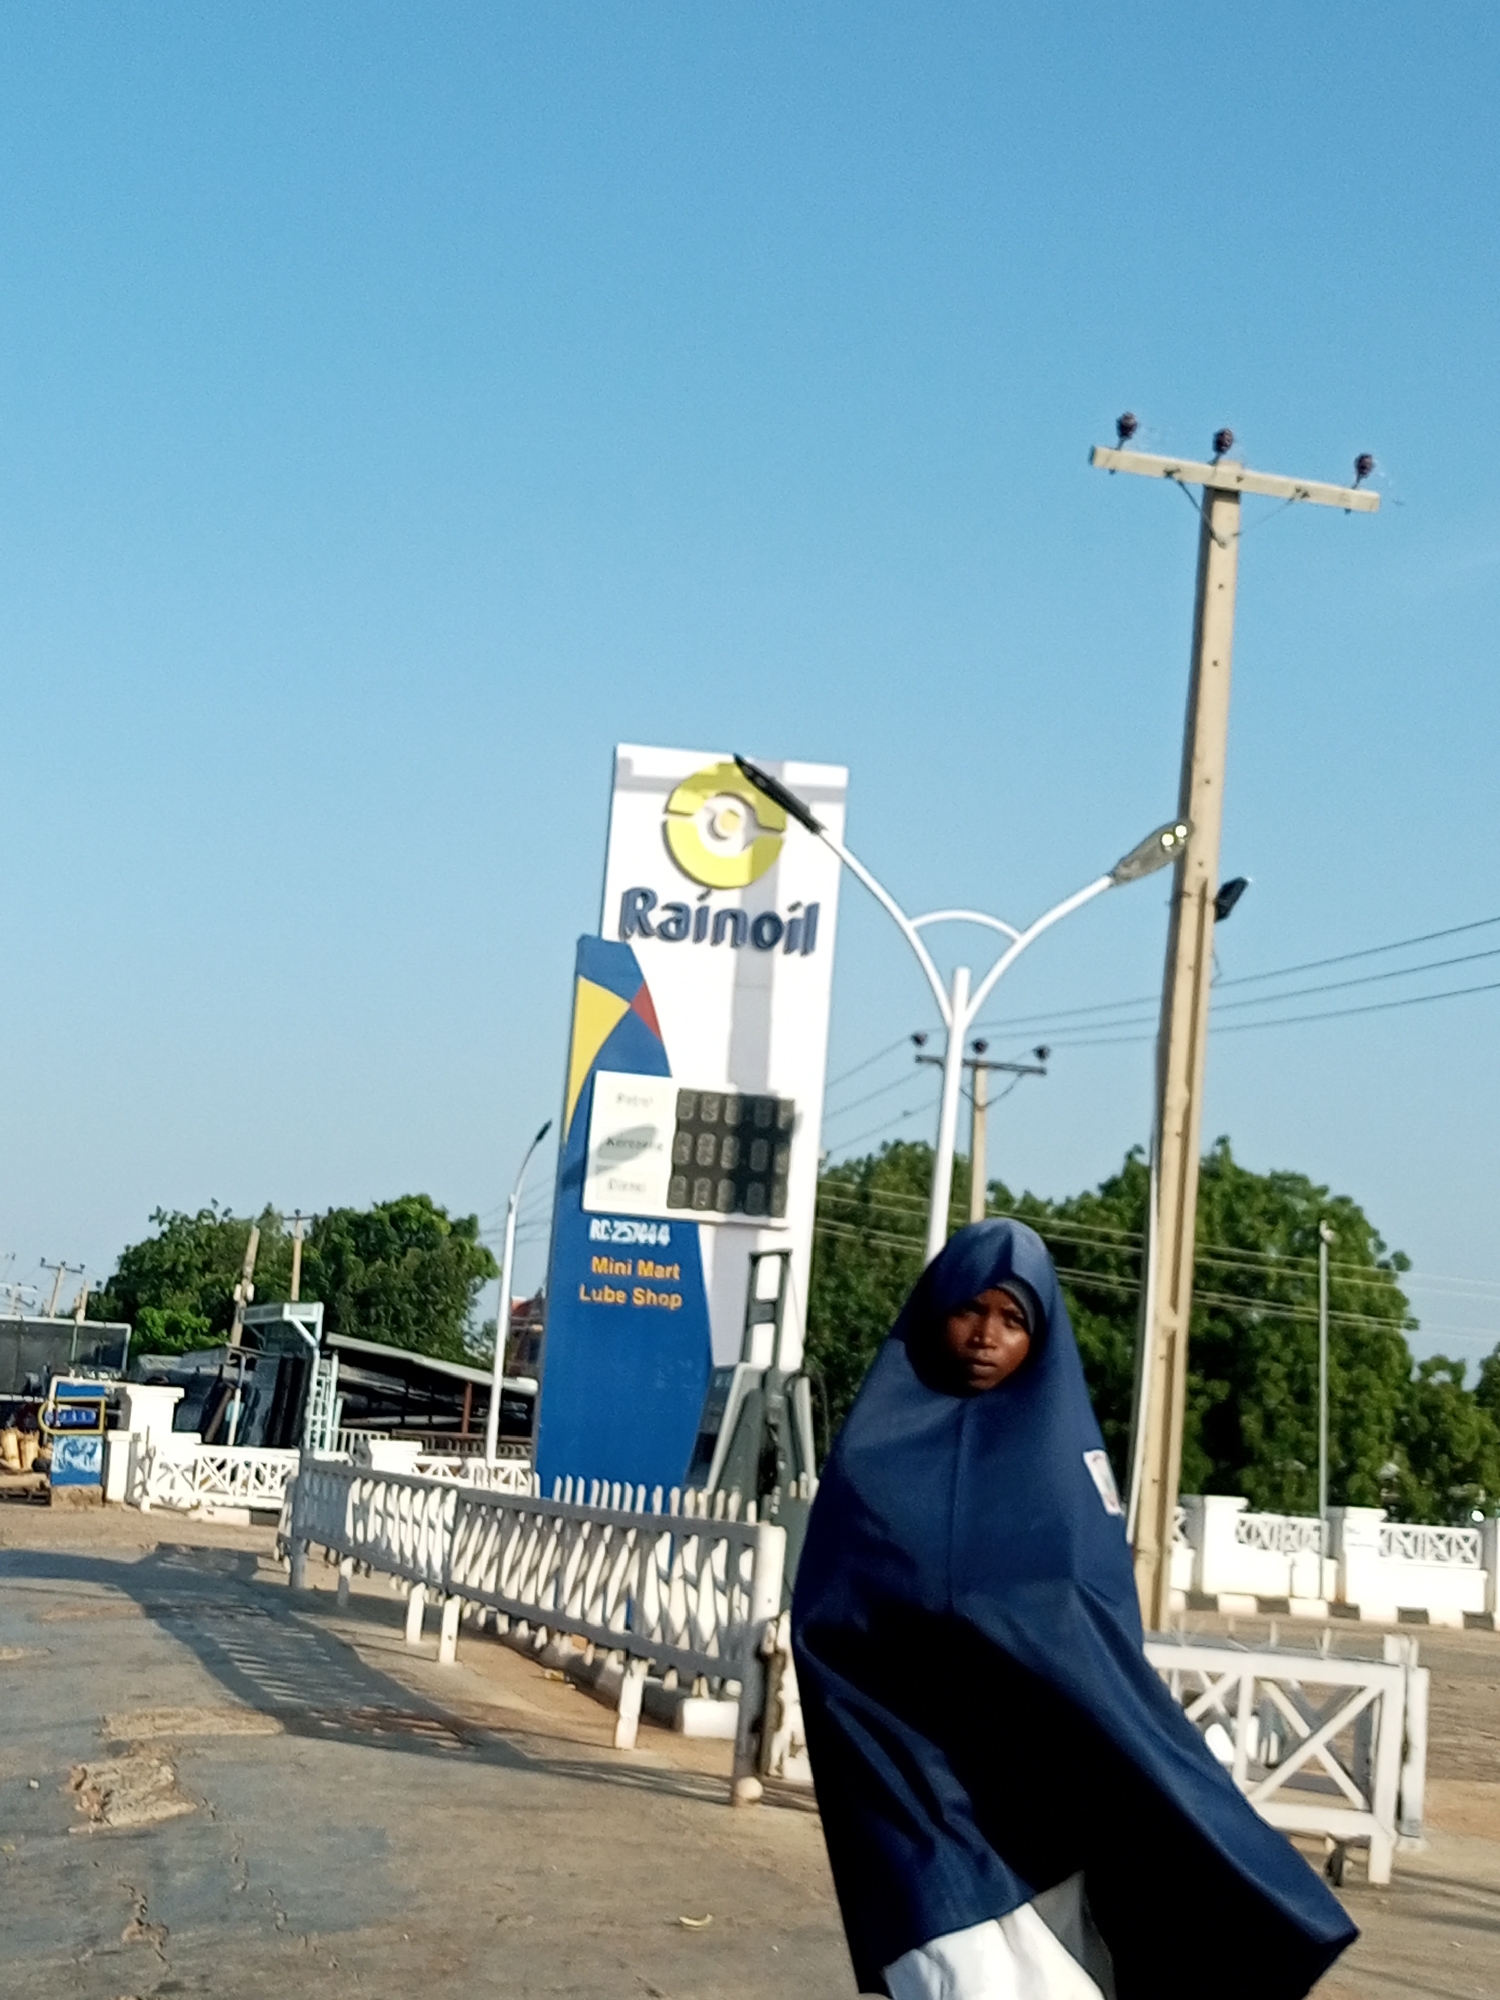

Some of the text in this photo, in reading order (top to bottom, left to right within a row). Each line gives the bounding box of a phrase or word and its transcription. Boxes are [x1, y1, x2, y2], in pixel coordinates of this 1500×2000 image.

[619, 886, 820, 956] Rainoil
[592, 1256, 680, 1280] Mini Mart
[580, 1283, 682, 1310] Lube Shop
